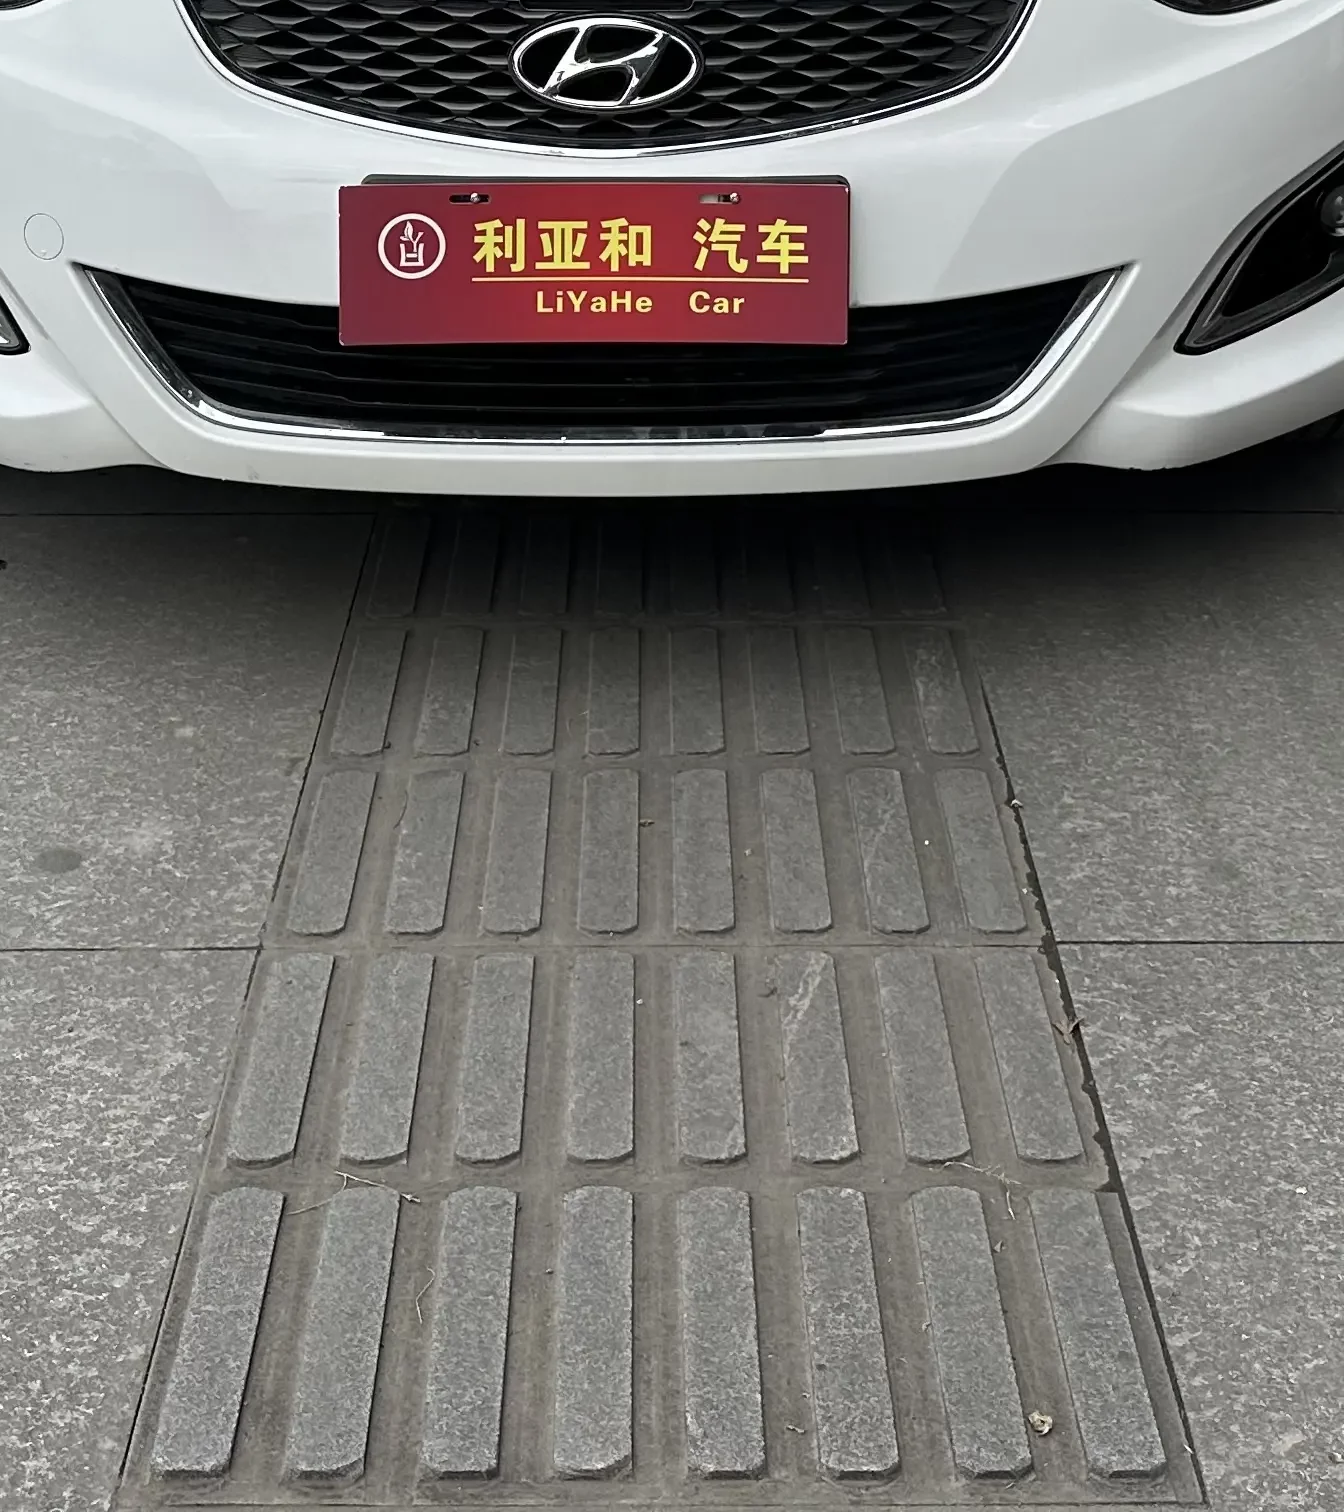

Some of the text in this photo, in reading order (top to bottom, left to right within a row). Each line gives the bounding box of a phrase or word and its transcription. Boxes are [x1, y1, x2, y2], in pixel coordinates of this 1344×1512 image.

[472, 217, 809, 274] 利亚和 汽车
[536, 290, 745, 314] LiYaHe Car
